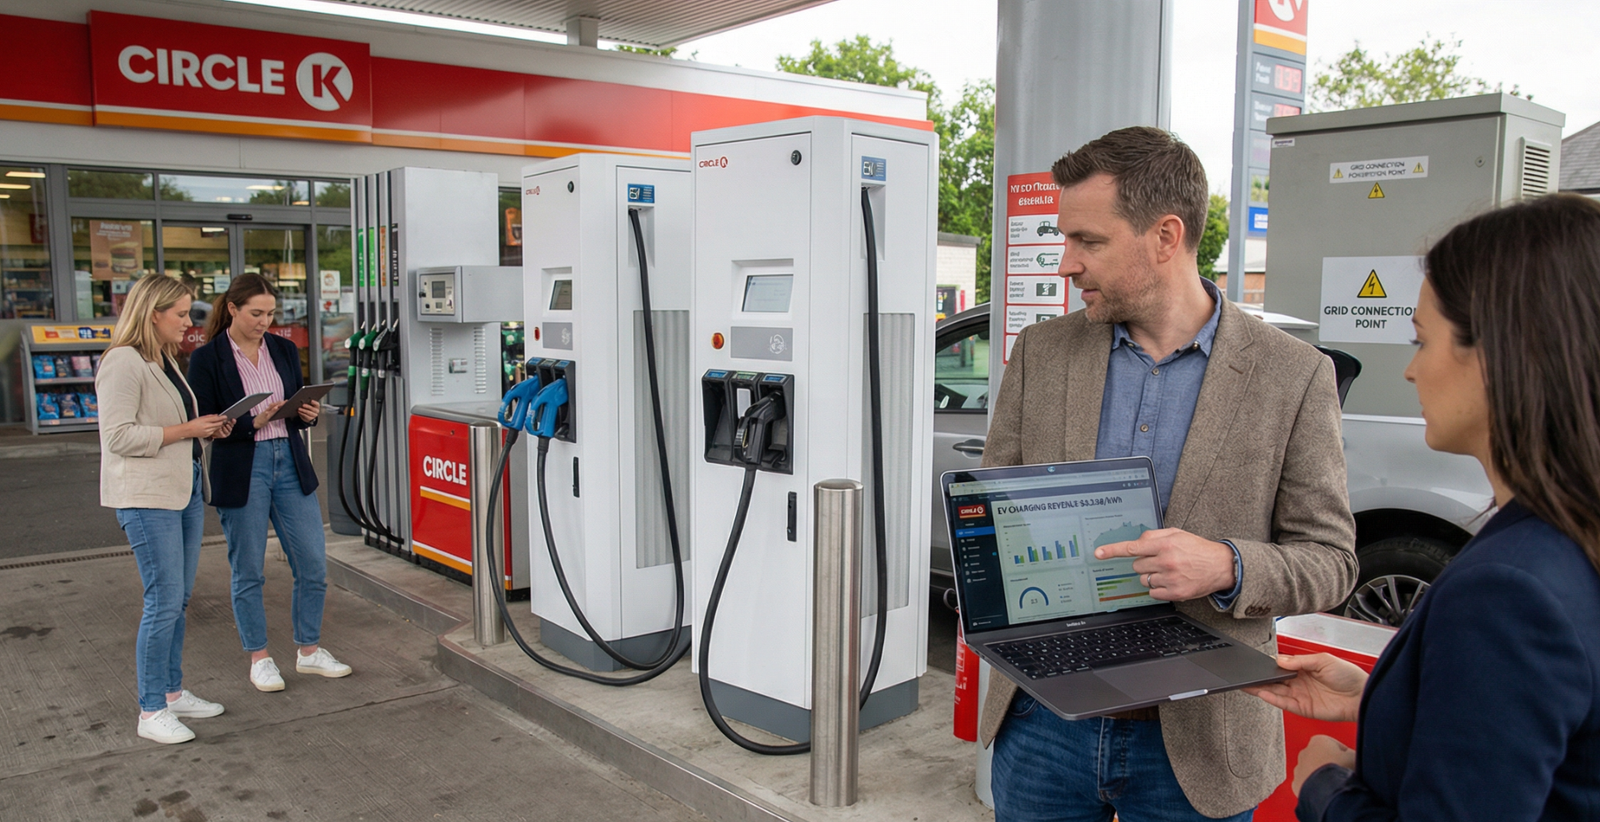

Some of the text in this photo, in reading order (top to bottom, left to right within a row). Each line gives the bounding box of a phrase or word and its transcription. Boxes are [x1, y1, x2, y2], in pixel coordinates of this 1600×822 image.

[118, 45, 353, 110] CIRCLE K
[1324, 306, 1349, 315] GRID
[1355, 319, 1387, 329] POINT
[422, 455, 467, 486] CIRCLE
